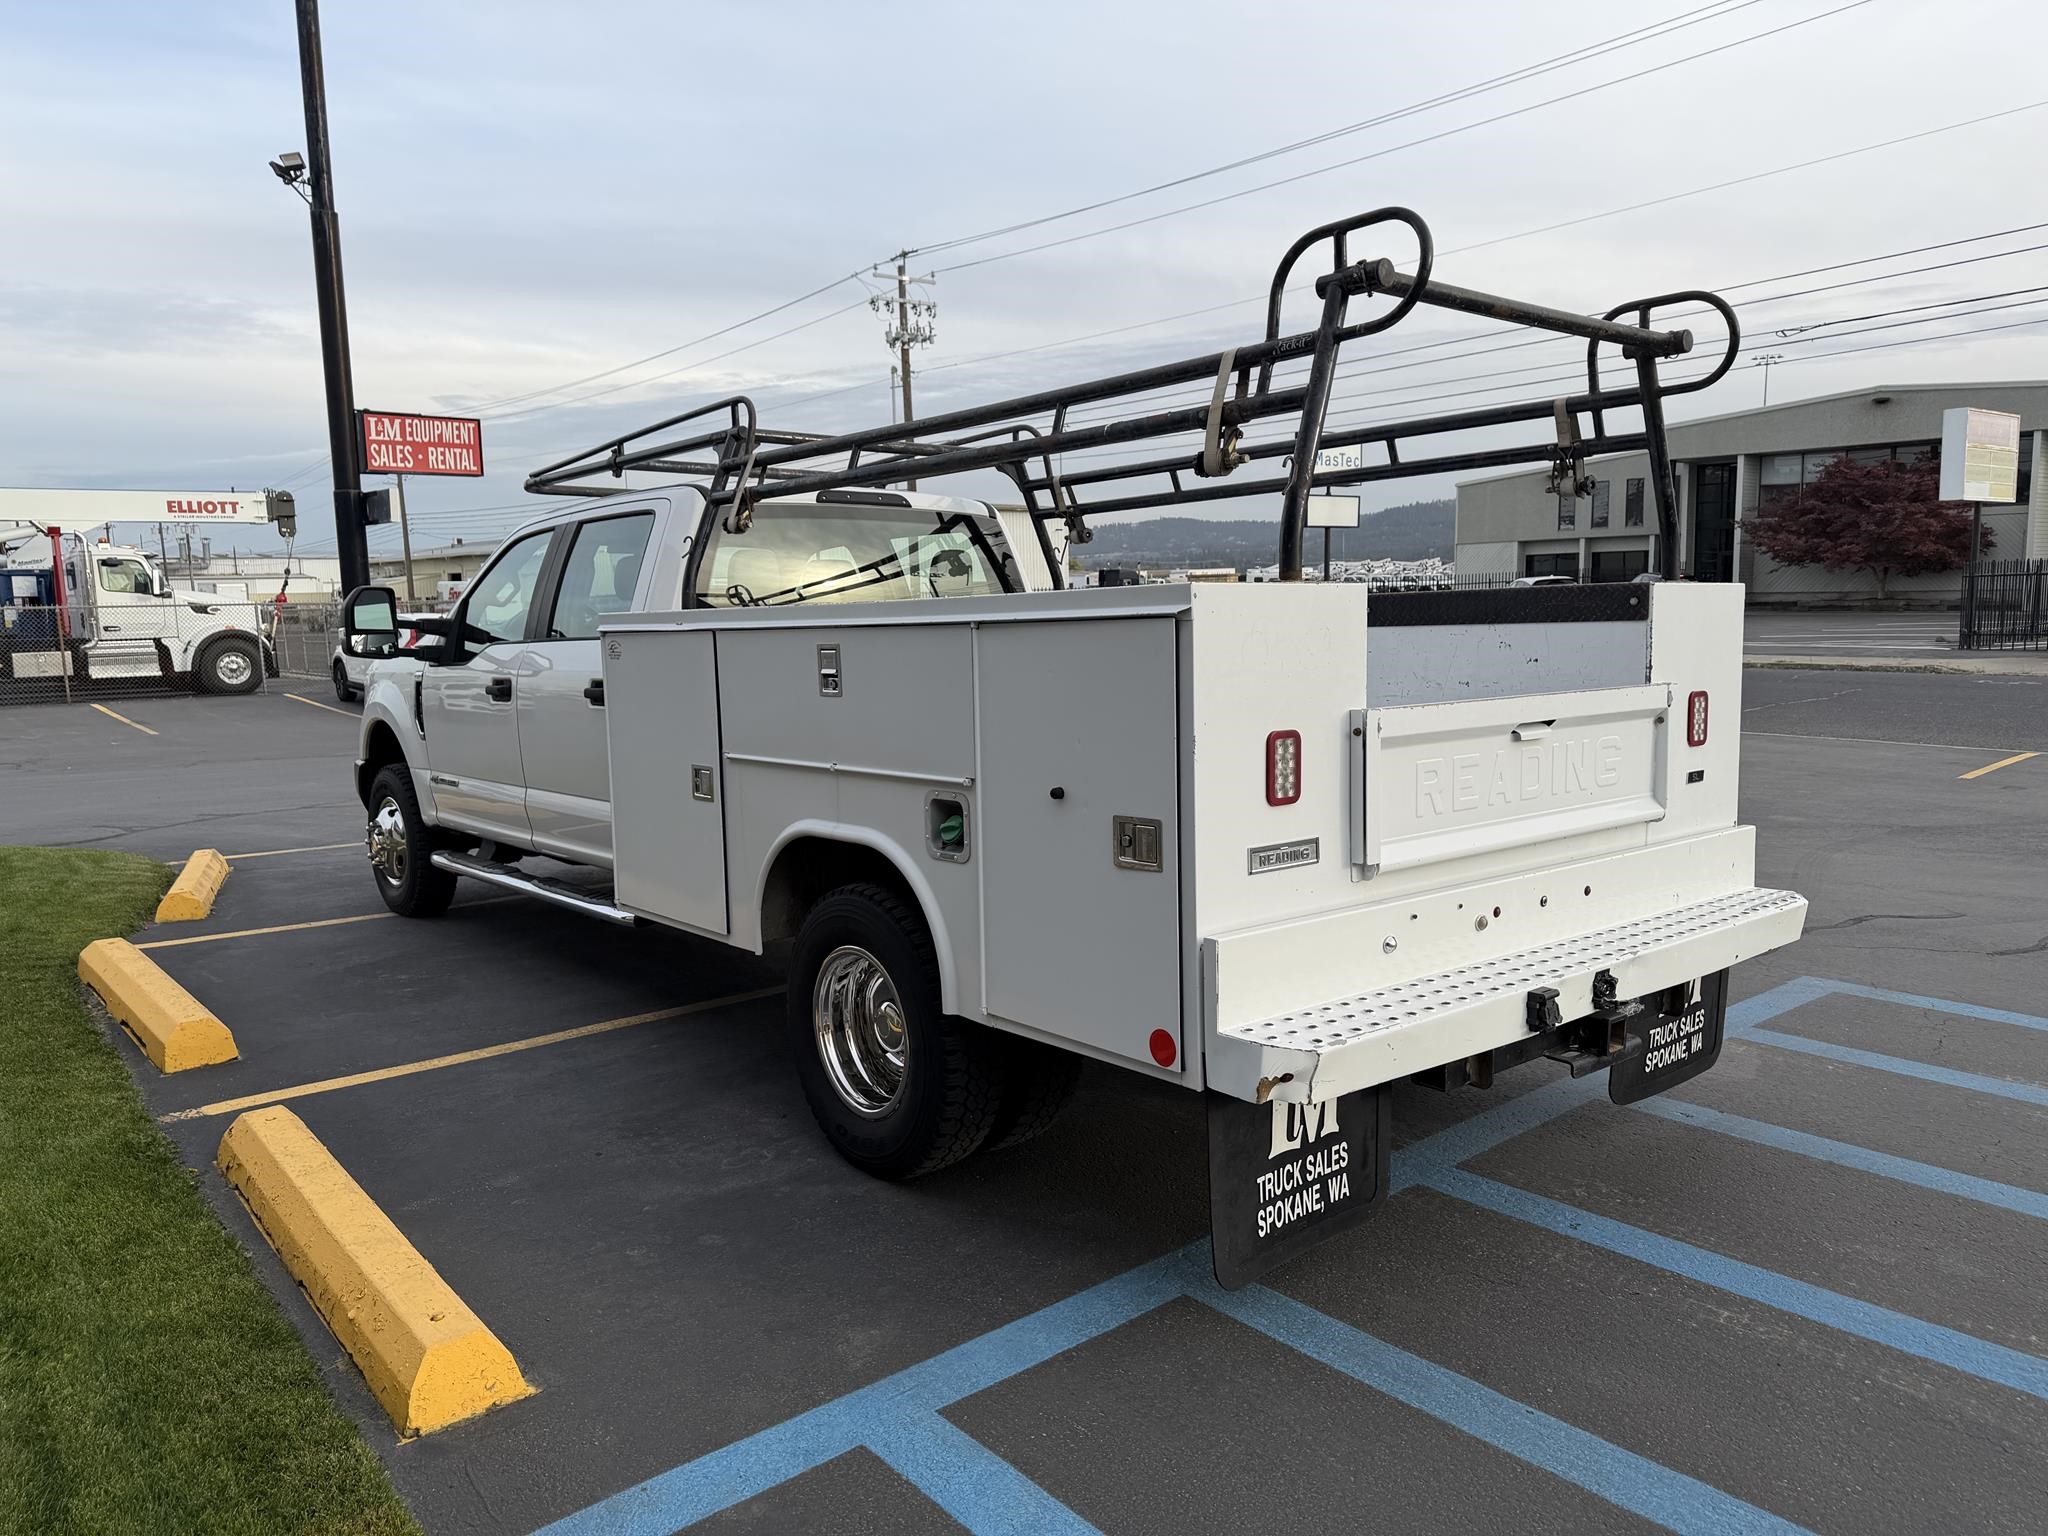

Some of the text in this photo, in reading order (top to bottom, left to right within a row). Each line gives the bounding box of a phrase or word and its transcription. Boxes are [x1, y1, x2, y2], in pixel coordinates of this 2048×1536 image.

[368, 417, 475, 445] L&M EQUIPMENT
[370, 443, 478, 471] SALES RENTAL
[1316, 453, 1360, 468] MasTec
[166, 500, 239, 514] ELLIOTT
[1415, 736, 1623, 818] READING
[1259, 848, 1310, 867] READING
[1649, 1009, 1705, 1049] TRUCK SALES
[1645, 1032, 1703, 1073] SPOKANE, WA
[1256, 1141, 1349, 1203] TRUCK SALES
[1257, 1172, 1350, 1238] SPOKANE, WA
